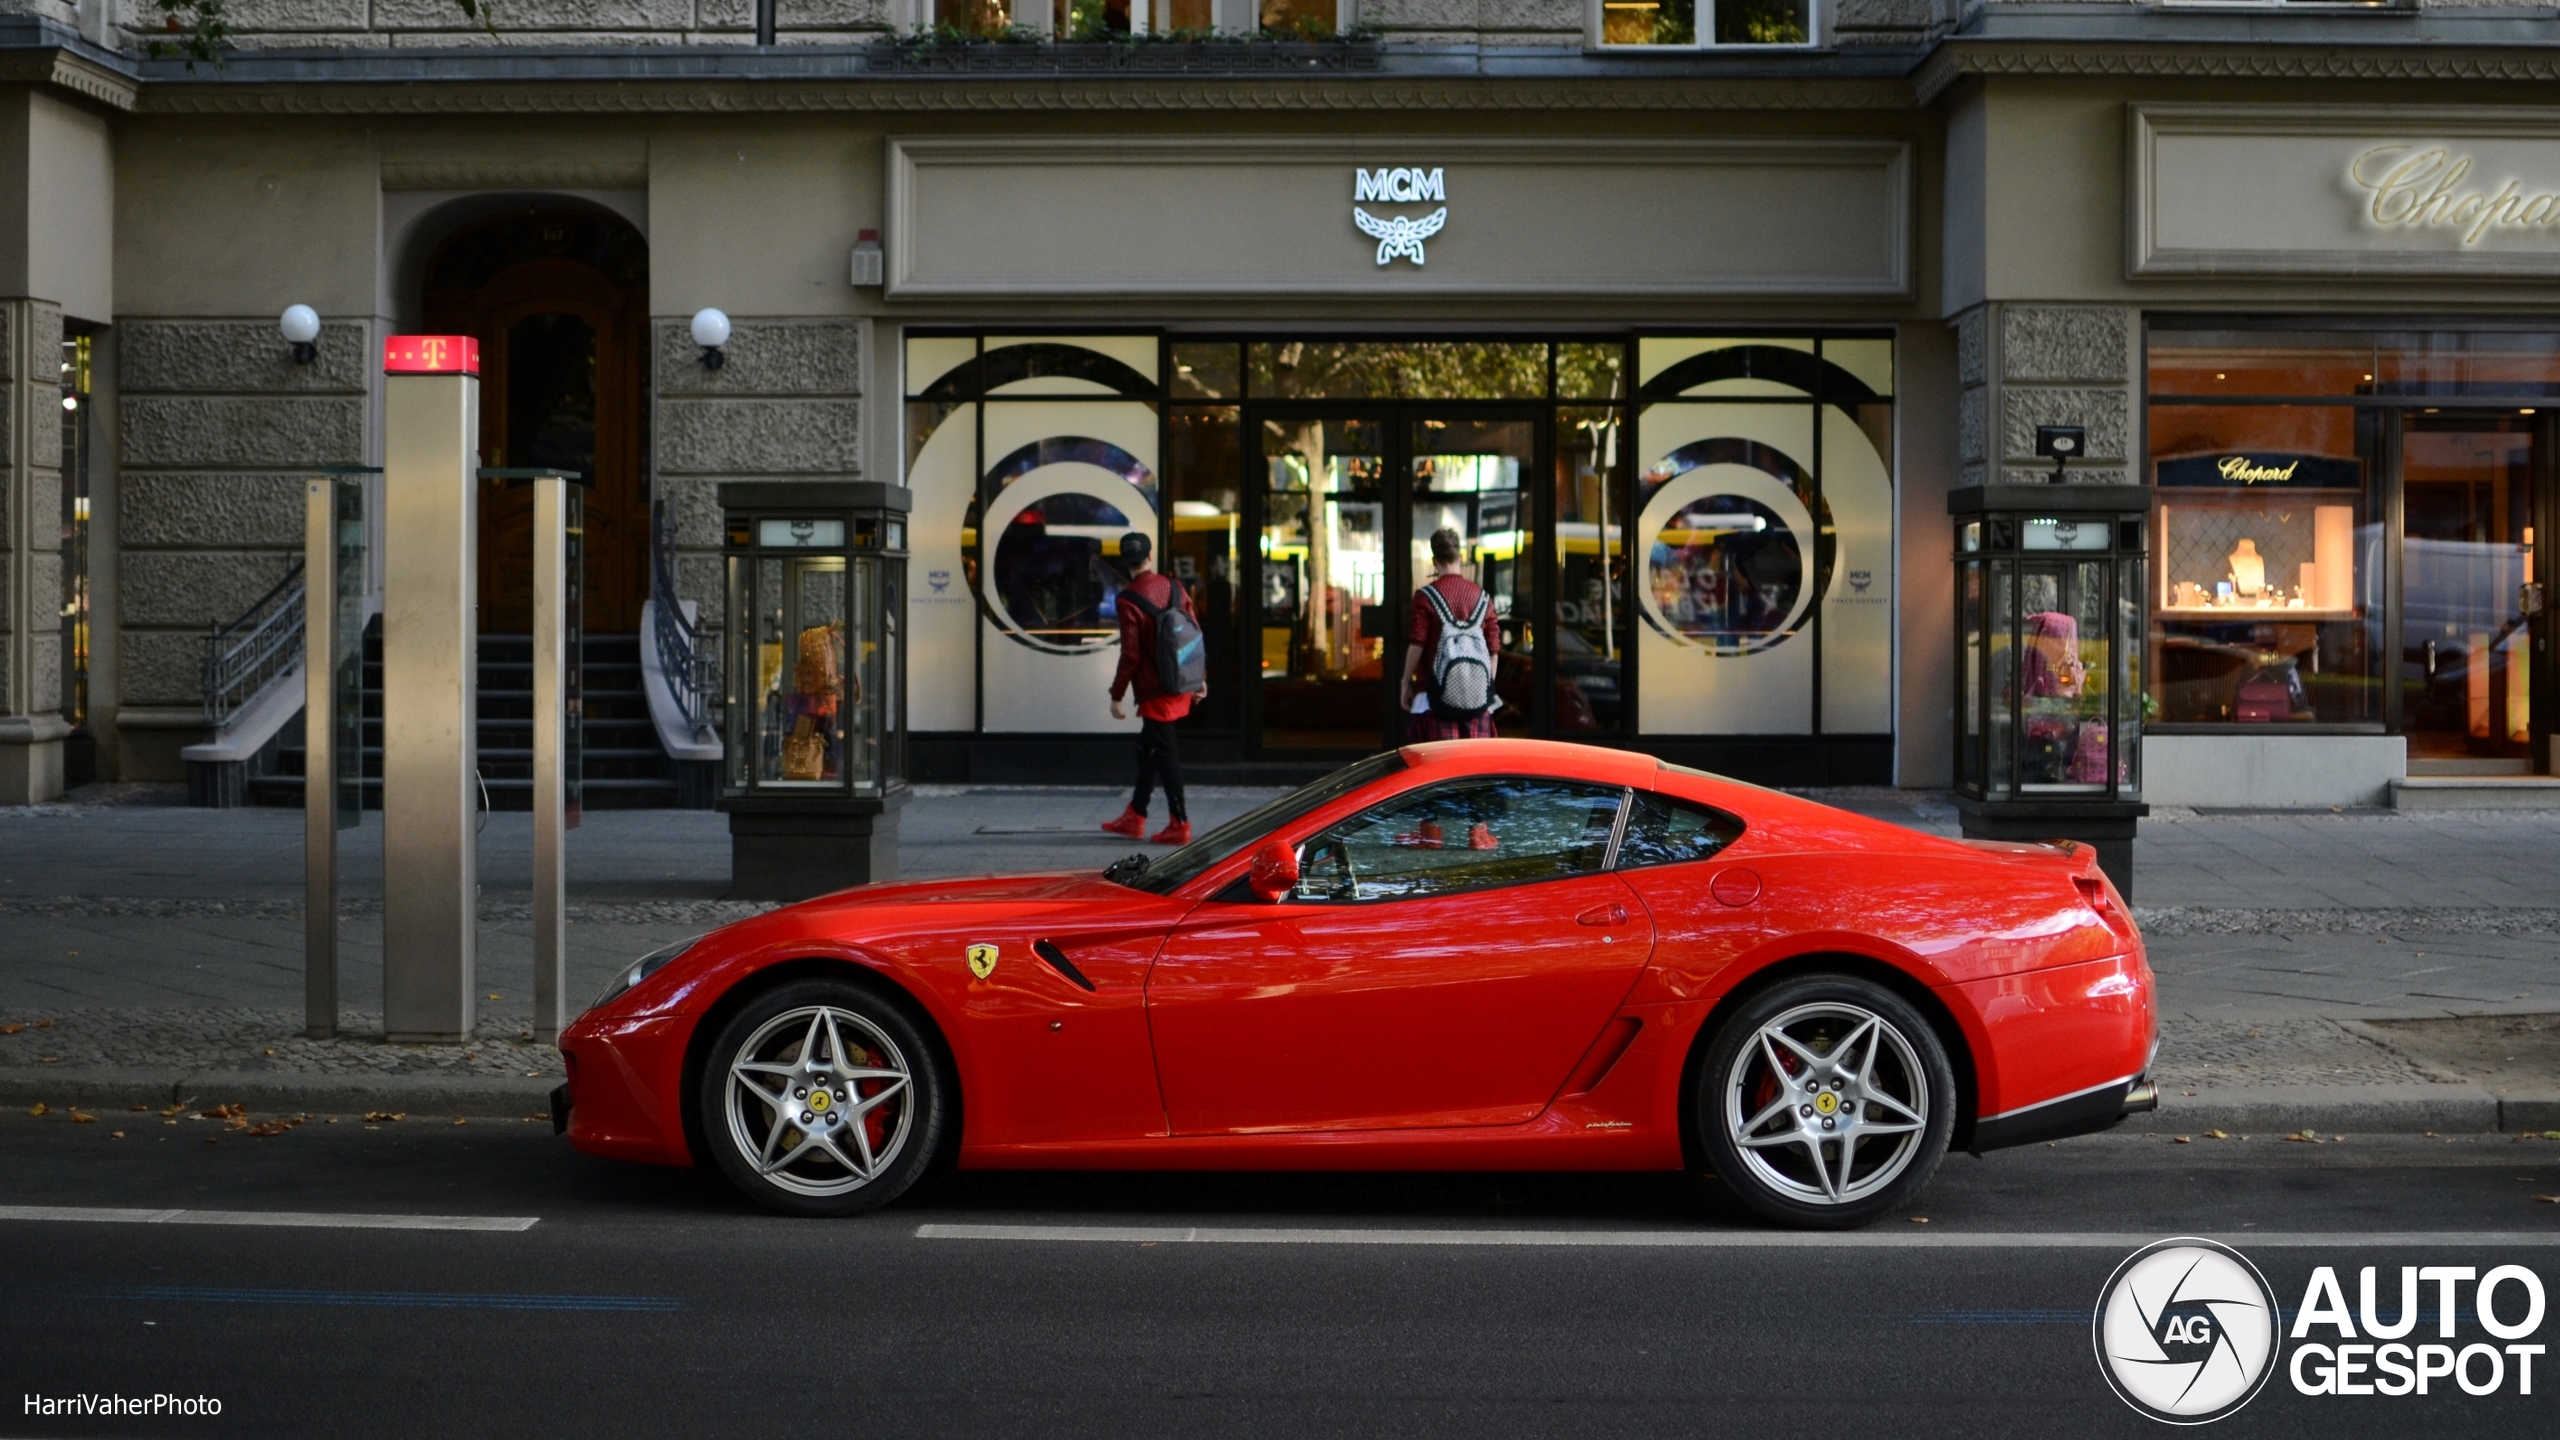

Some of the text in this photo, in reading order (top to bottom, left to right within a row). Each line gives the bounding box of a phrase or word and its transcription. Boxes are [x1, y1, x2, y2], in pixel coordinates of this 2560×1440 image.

[1353, 167, 1447, 202] MCM
[421, 338, 447, 369] T
[2217, 456, 2299, 486] Chopard
[1849, 570, 1872, 579] MCM
